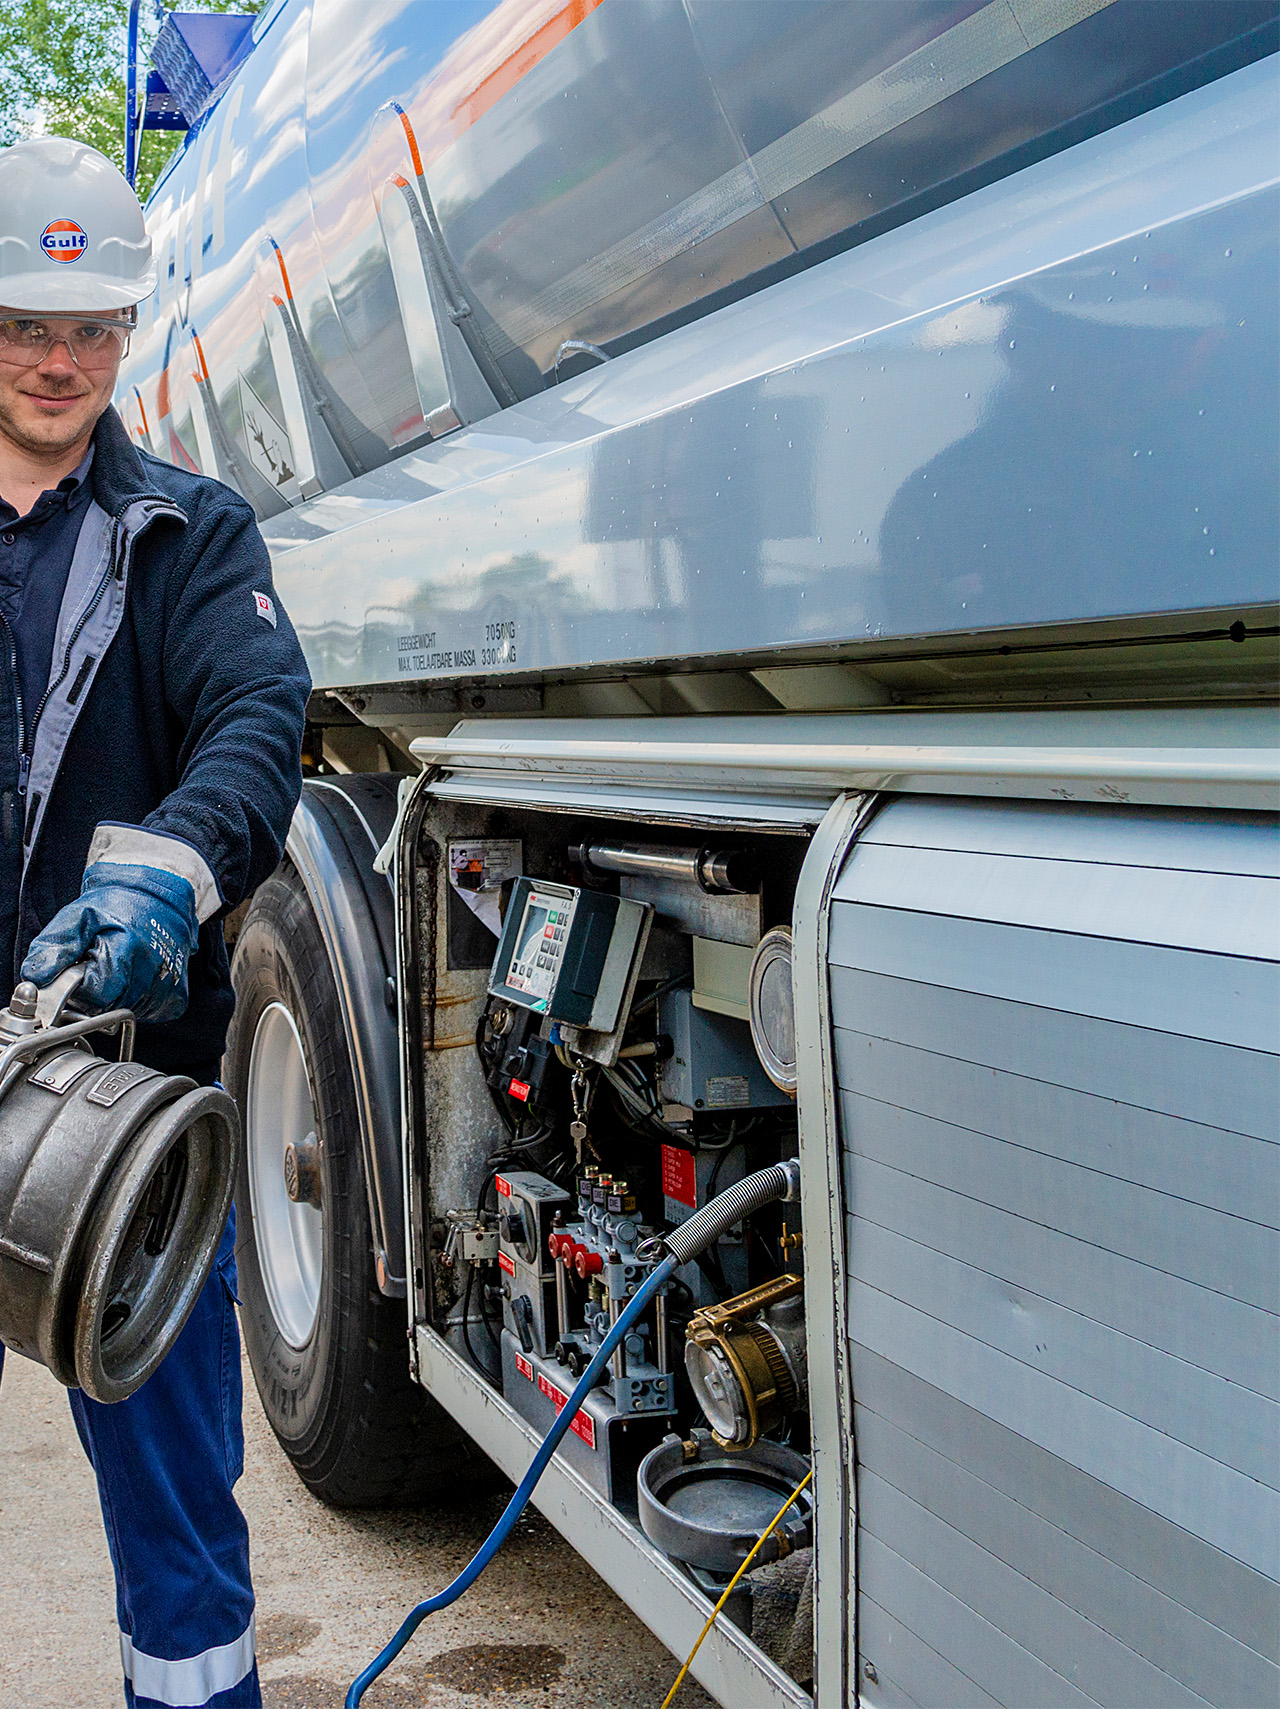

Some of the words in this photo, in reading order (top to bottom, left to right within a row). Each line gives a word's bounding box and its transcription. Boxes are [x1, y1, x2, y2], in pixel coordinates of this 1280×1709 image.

[42, 235, 86, 248] Gulf
[397, 632, 436, 652] LEEGGEWICHT
[413, 651, 453, 671] TOELAATBARE
[454, 649, 477, 667] MASSA
